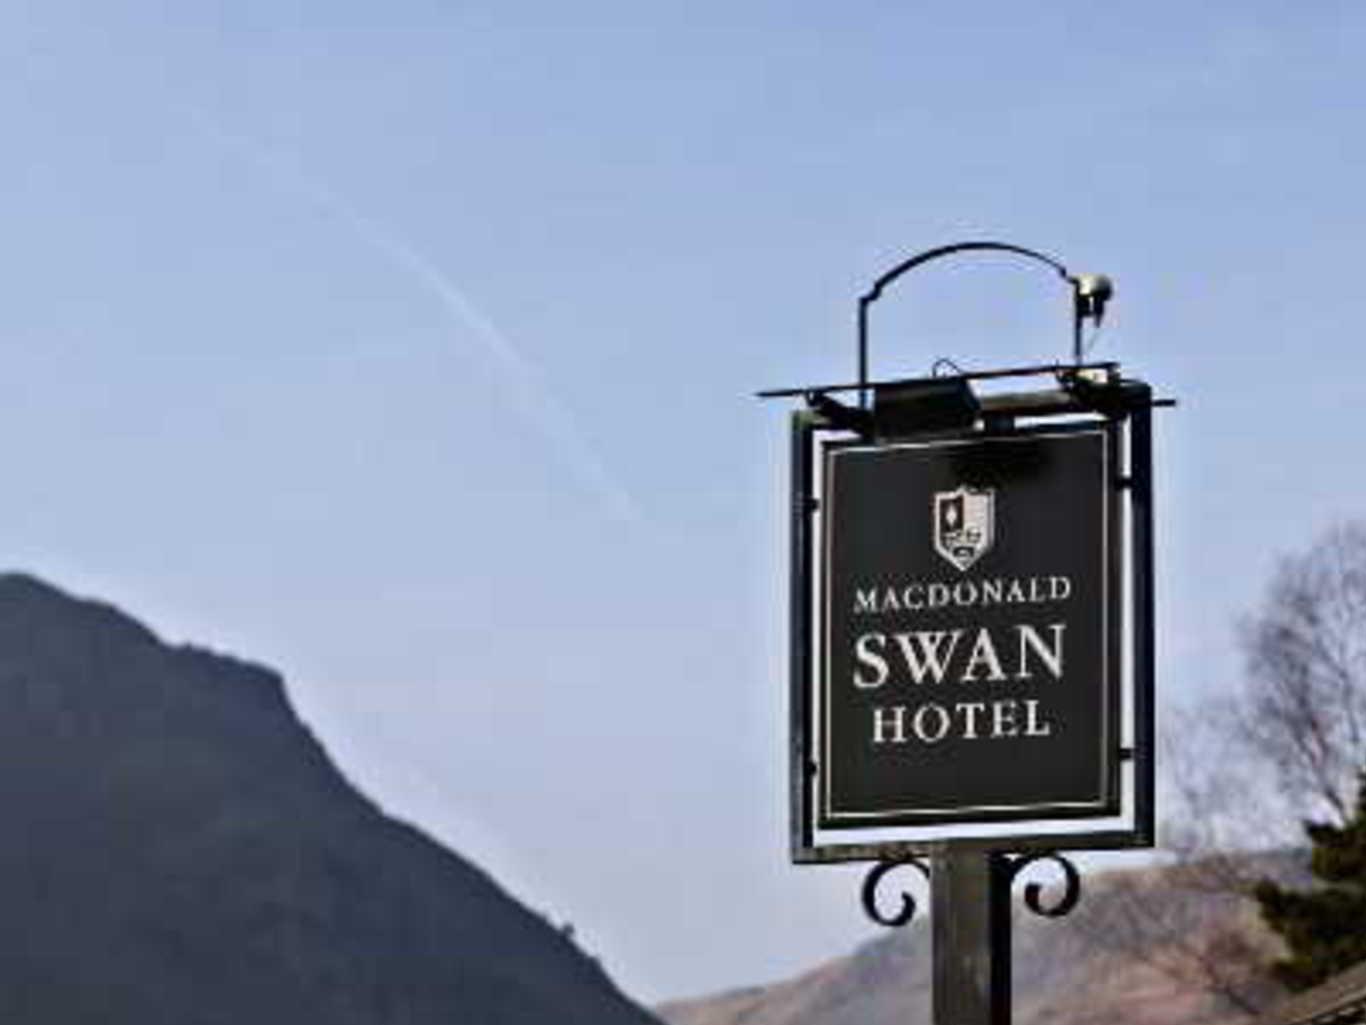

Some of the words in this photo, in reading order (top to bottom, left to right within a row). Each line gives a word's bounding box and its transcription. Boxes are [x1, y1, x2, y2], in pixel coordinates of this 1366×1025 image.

[854, 577, 1071, 613] MACDONALD
[854, 625, 1066, 688] SWAN
[873, 700, 1051, 743] HOTEL
